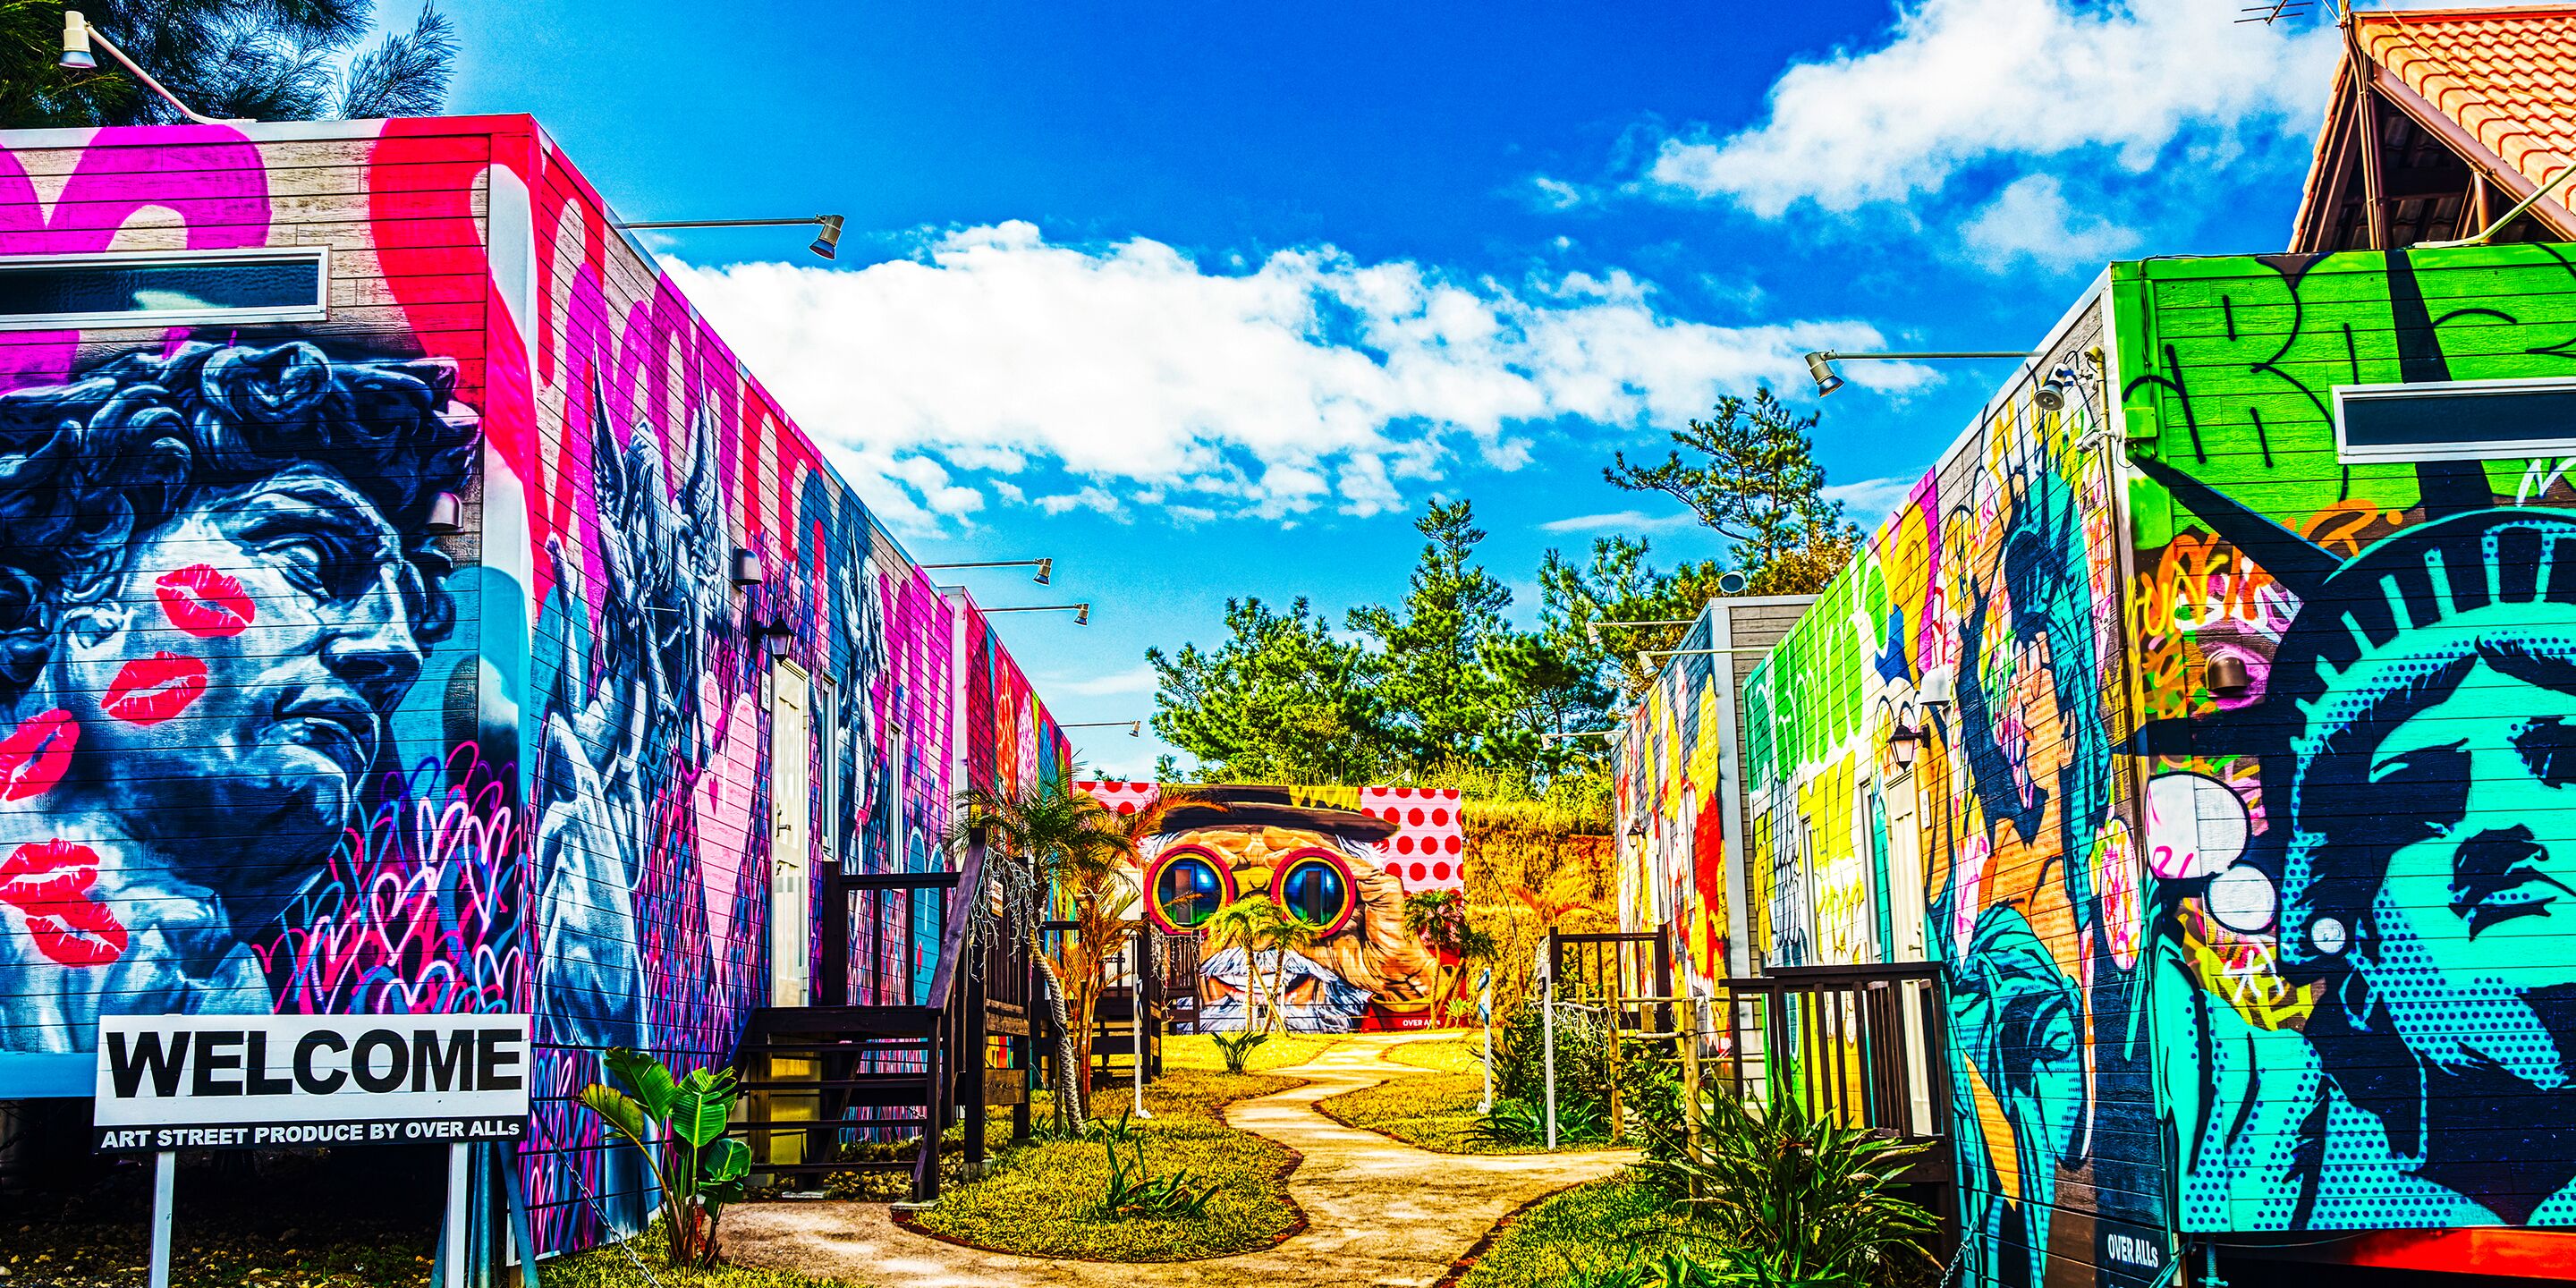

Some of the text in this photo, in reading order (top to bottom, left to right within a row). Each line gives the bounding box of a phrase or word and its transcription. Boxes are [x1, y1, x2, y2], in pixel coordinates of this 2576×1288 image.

[106, 1029, 522, 1098] WELCOME
[101, 1130, 151, 1148] ART
[157, 1128, 248, 1147] STREET
[255, 1124, 364, 1144] PRODUCE
[369, 1123, 401, 1140] BY
[406, 1121, 465, 1139] OVER
[2107, 1233, 2134, 1264] OVER
